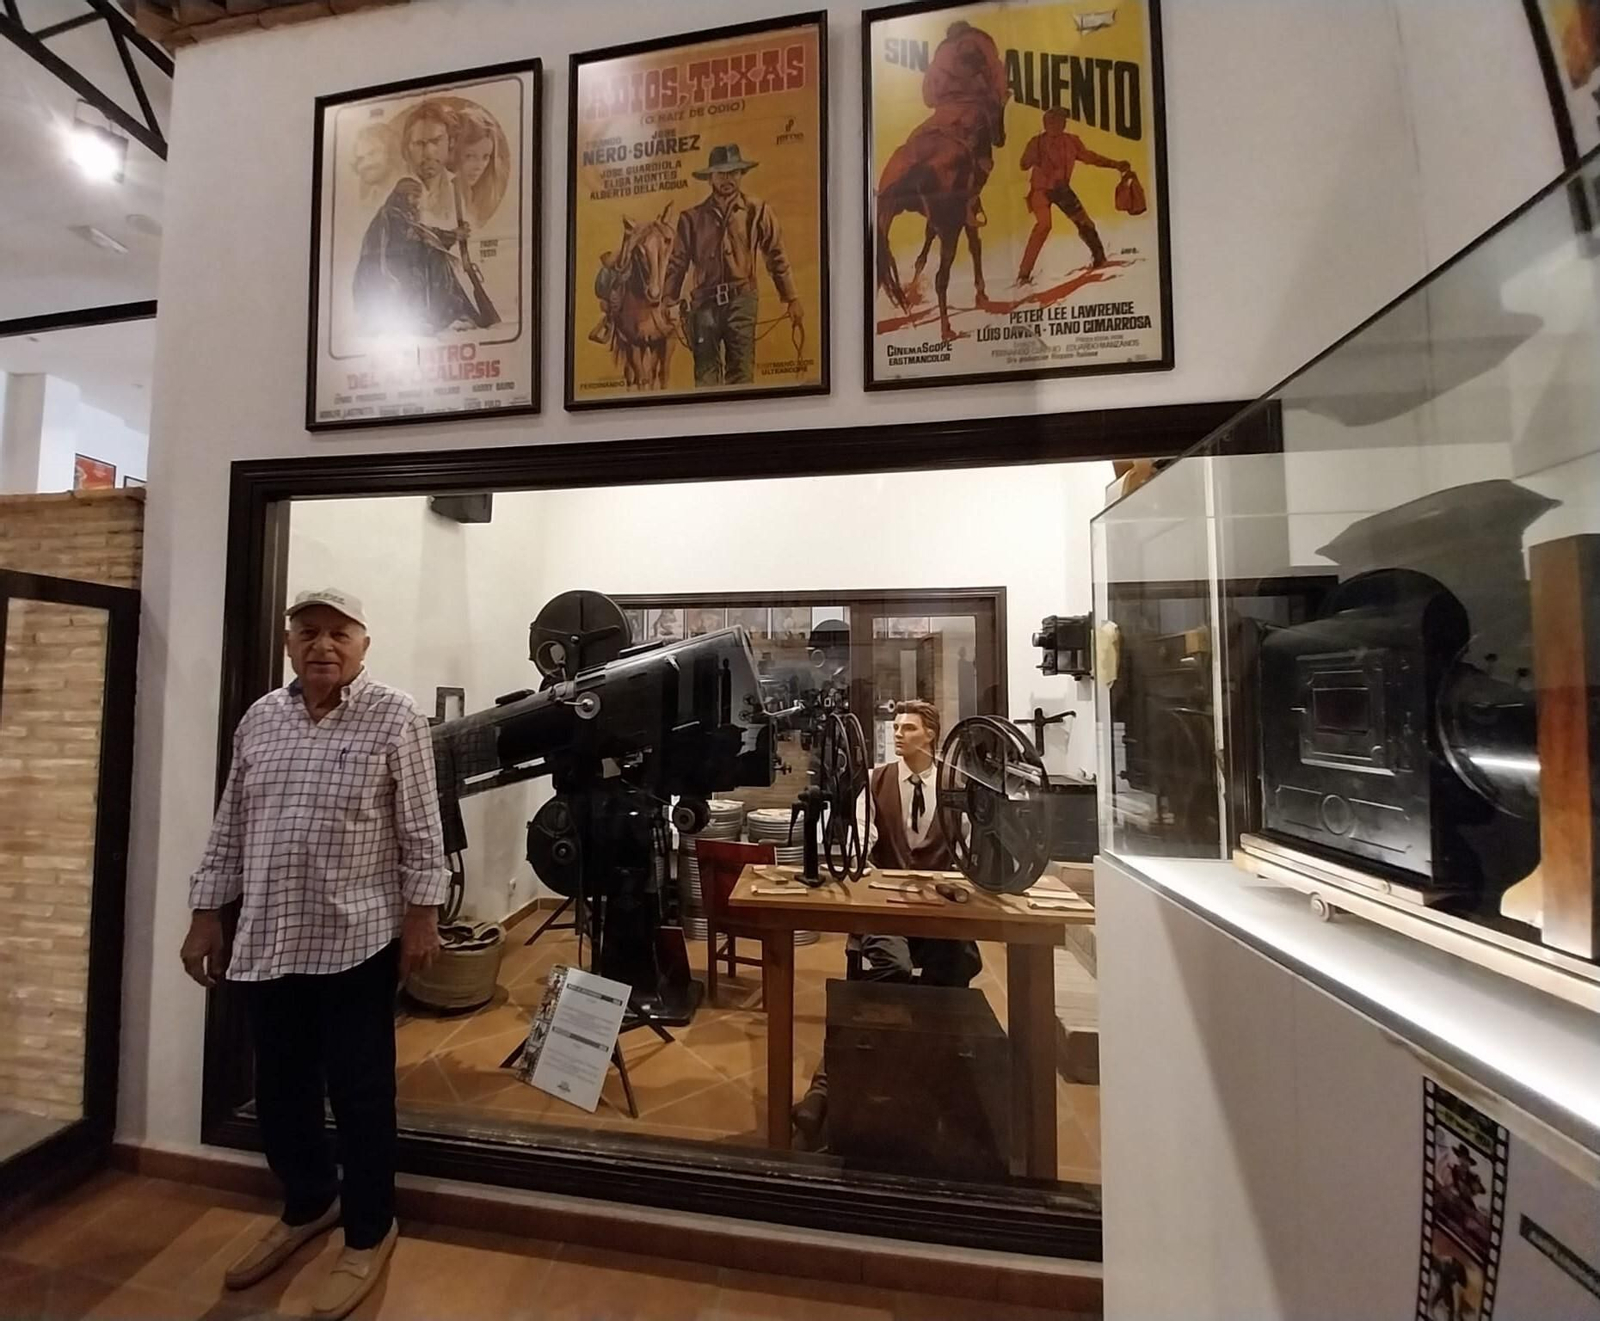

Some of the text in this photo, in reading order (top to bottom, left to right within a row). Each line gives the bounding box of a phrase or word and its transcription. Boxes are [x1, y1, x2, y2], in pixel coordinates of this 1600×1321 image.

[687, 43, 805, 104] TEXAS
[884, 37, 1143, 141] SIN ALIENTO
[583, 134, 701, 167] NERO SUAREZ
[1010, 301, 1135, 324] PETER LEE LAWRENCE
[1049, 319, 1081, 336] TANO
[1083, 315, 1152, 333] CIMARROSA
[888, 353, 951, 366] EASTMANCOLOR
